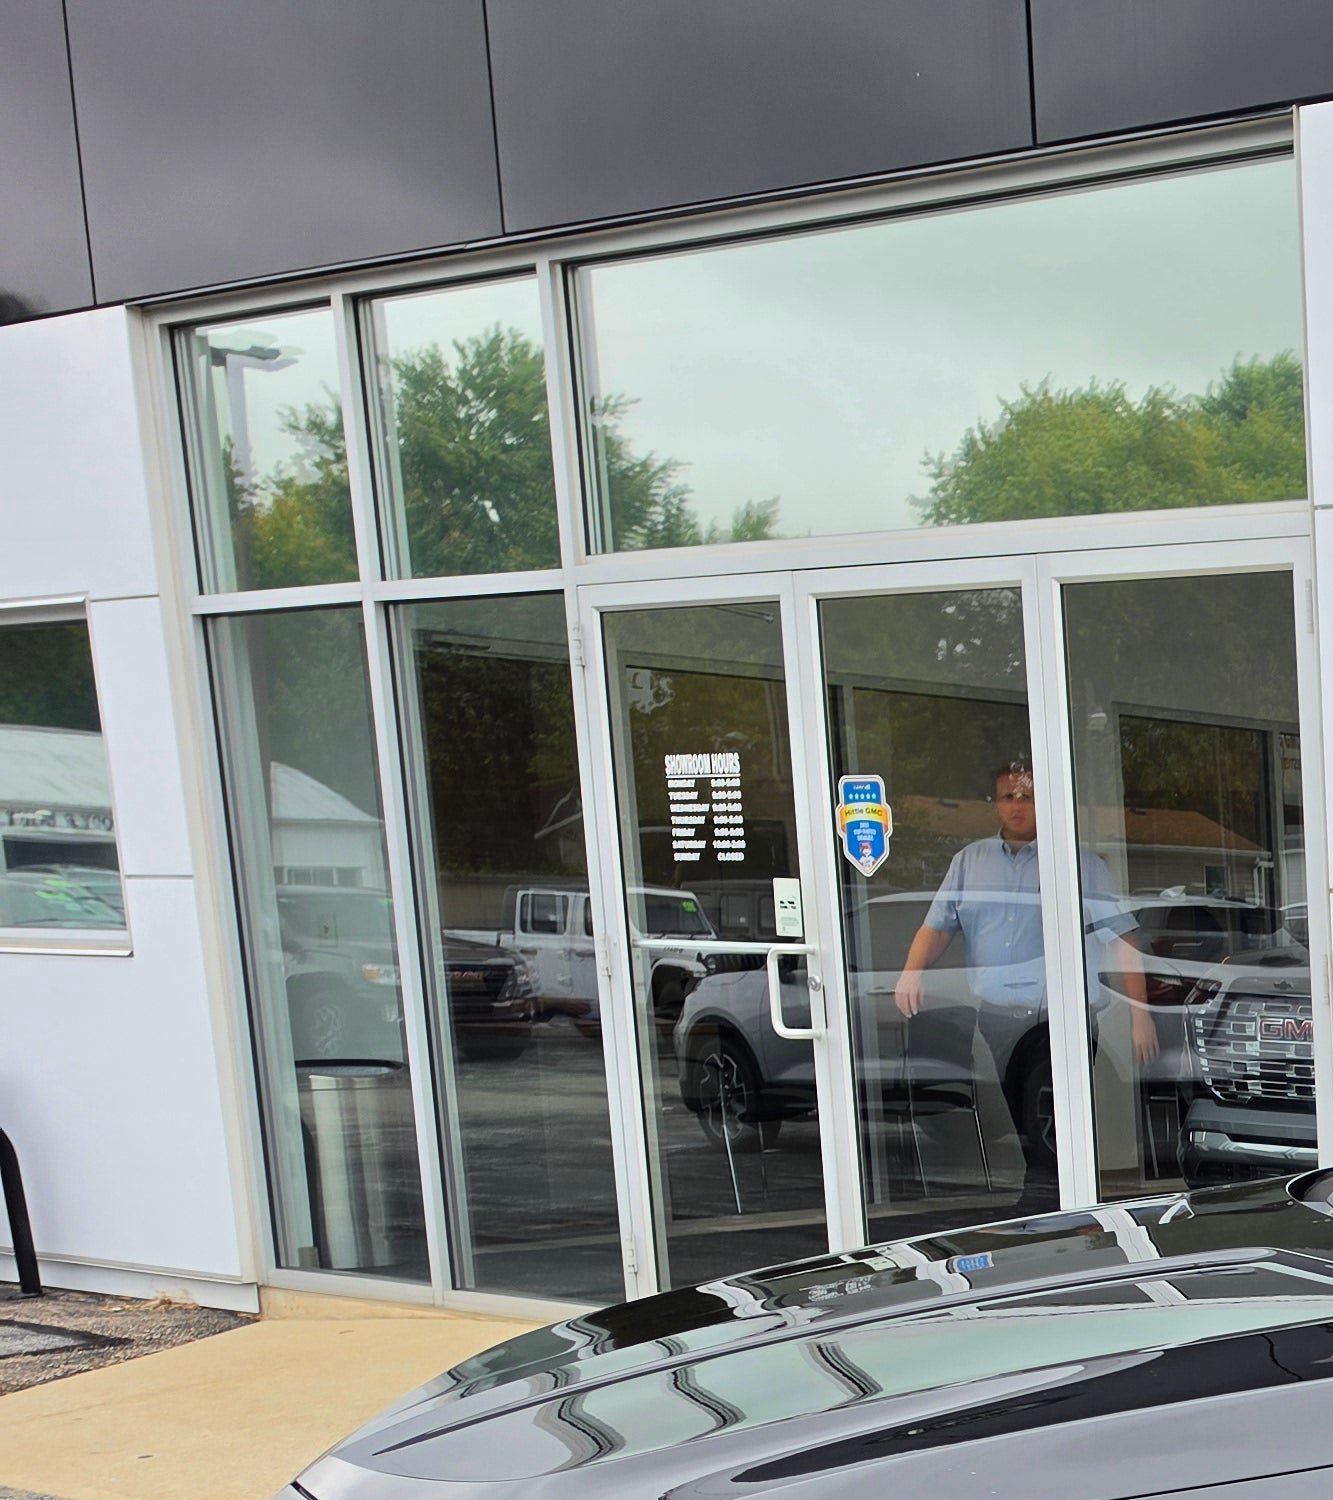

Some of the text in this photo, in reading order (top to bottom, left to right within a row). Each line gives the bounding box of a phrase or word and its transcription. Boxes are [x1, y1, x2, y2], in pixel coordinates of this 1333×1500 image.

[665, 752, 740, 775] SHOWROOM HOURS
[865, 807, 883, 817] GMC
[1259, 1018, 1313, 1041] GM
